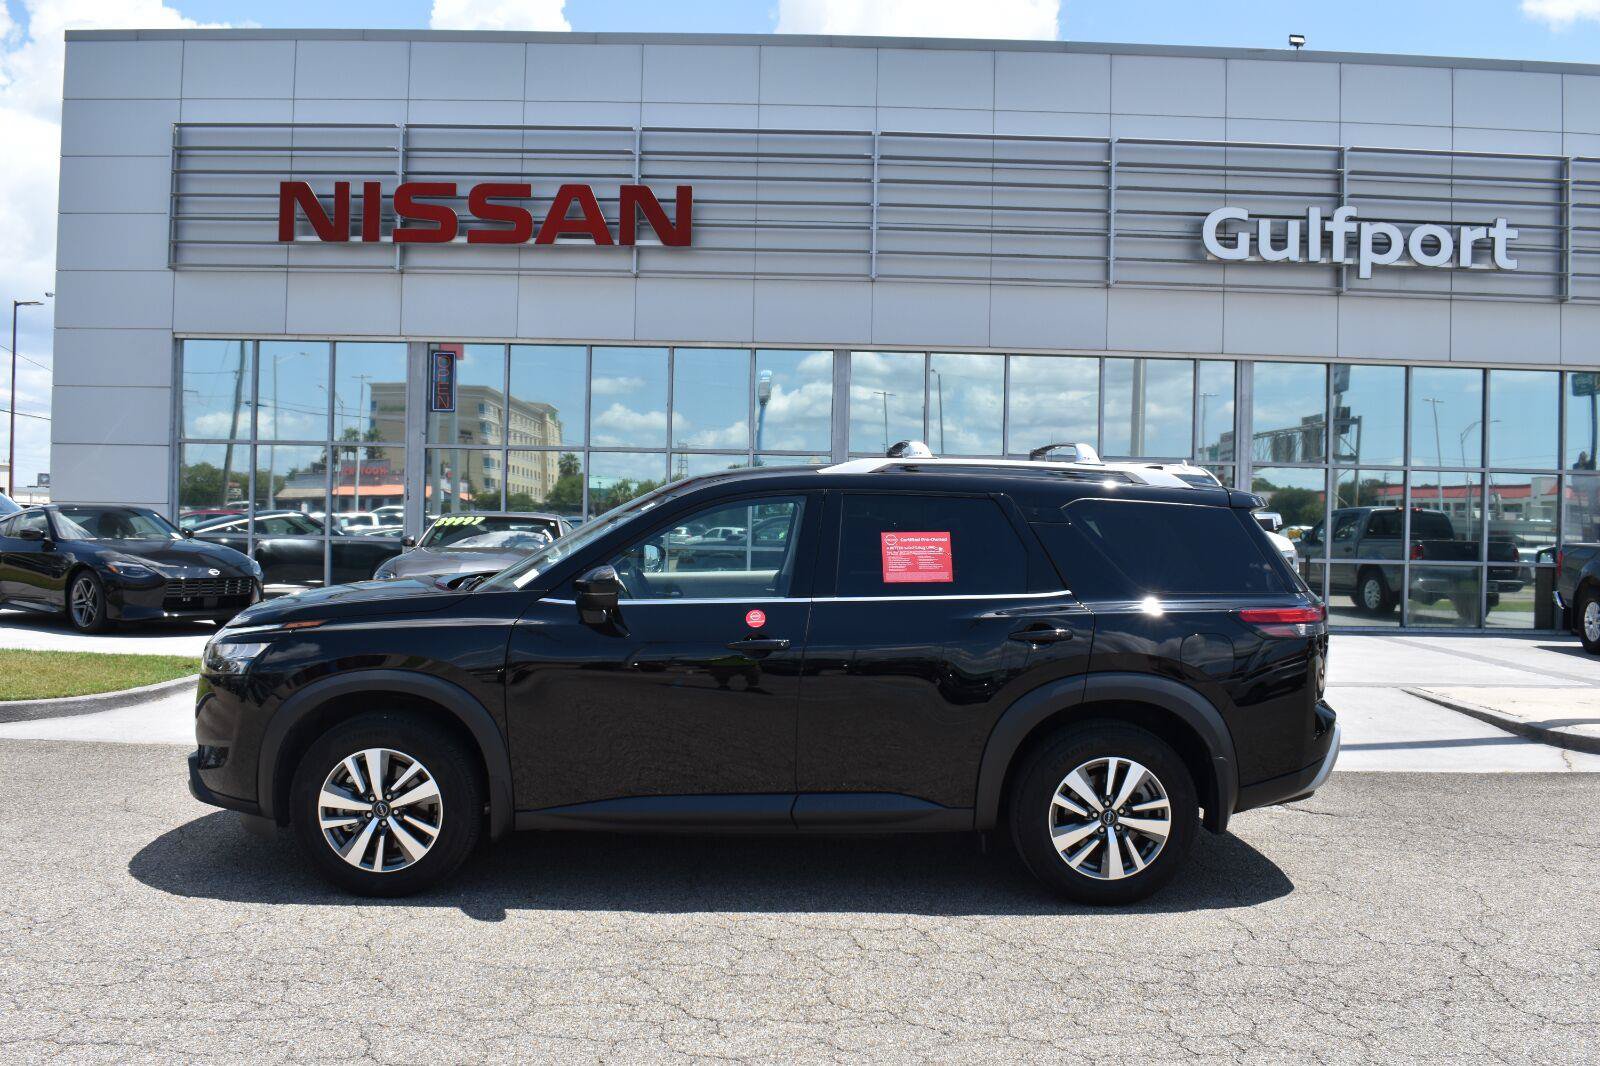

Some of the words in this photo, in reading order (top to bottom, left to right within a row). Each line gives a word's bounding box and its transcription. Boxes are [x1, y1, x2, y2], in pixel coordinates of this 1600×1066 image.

[278, 181, 692, 247] NISSAN
[1202, 205, 1519, 279] Gulfport
[437, 355, 451, 409] OPEN
